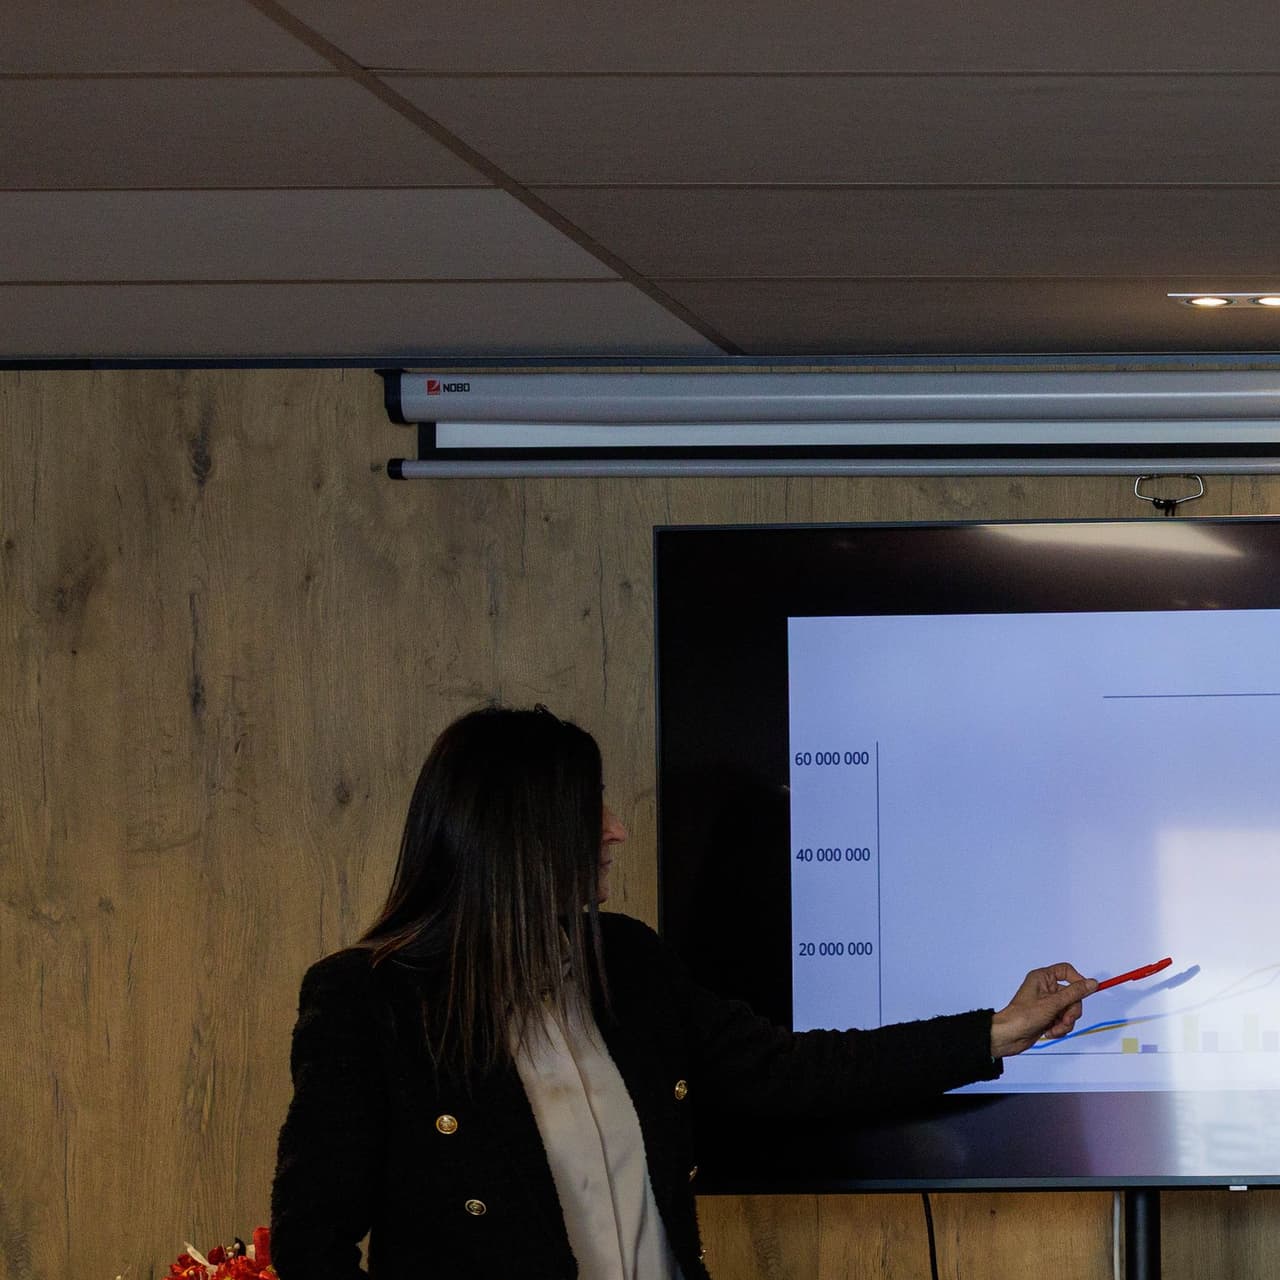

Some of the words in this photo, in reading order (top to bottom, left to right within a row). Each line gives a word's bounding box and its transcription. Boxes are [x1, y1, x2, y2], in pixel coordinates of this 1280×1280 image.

[443, 382, 470, 393] NOBO
[795, 751, 811, 766] 60
[815, 751, 840, 766] 000
[844, 751, 869, 766] 000
[796, 848, 813, 862] 40
[817, 848, 842, 862] 000
[845, 847, 870, 861] 000
[799, 943, 815, 957] 20
[819, 942, 844, 956] 000
[848, 942, 872, 955] 000
